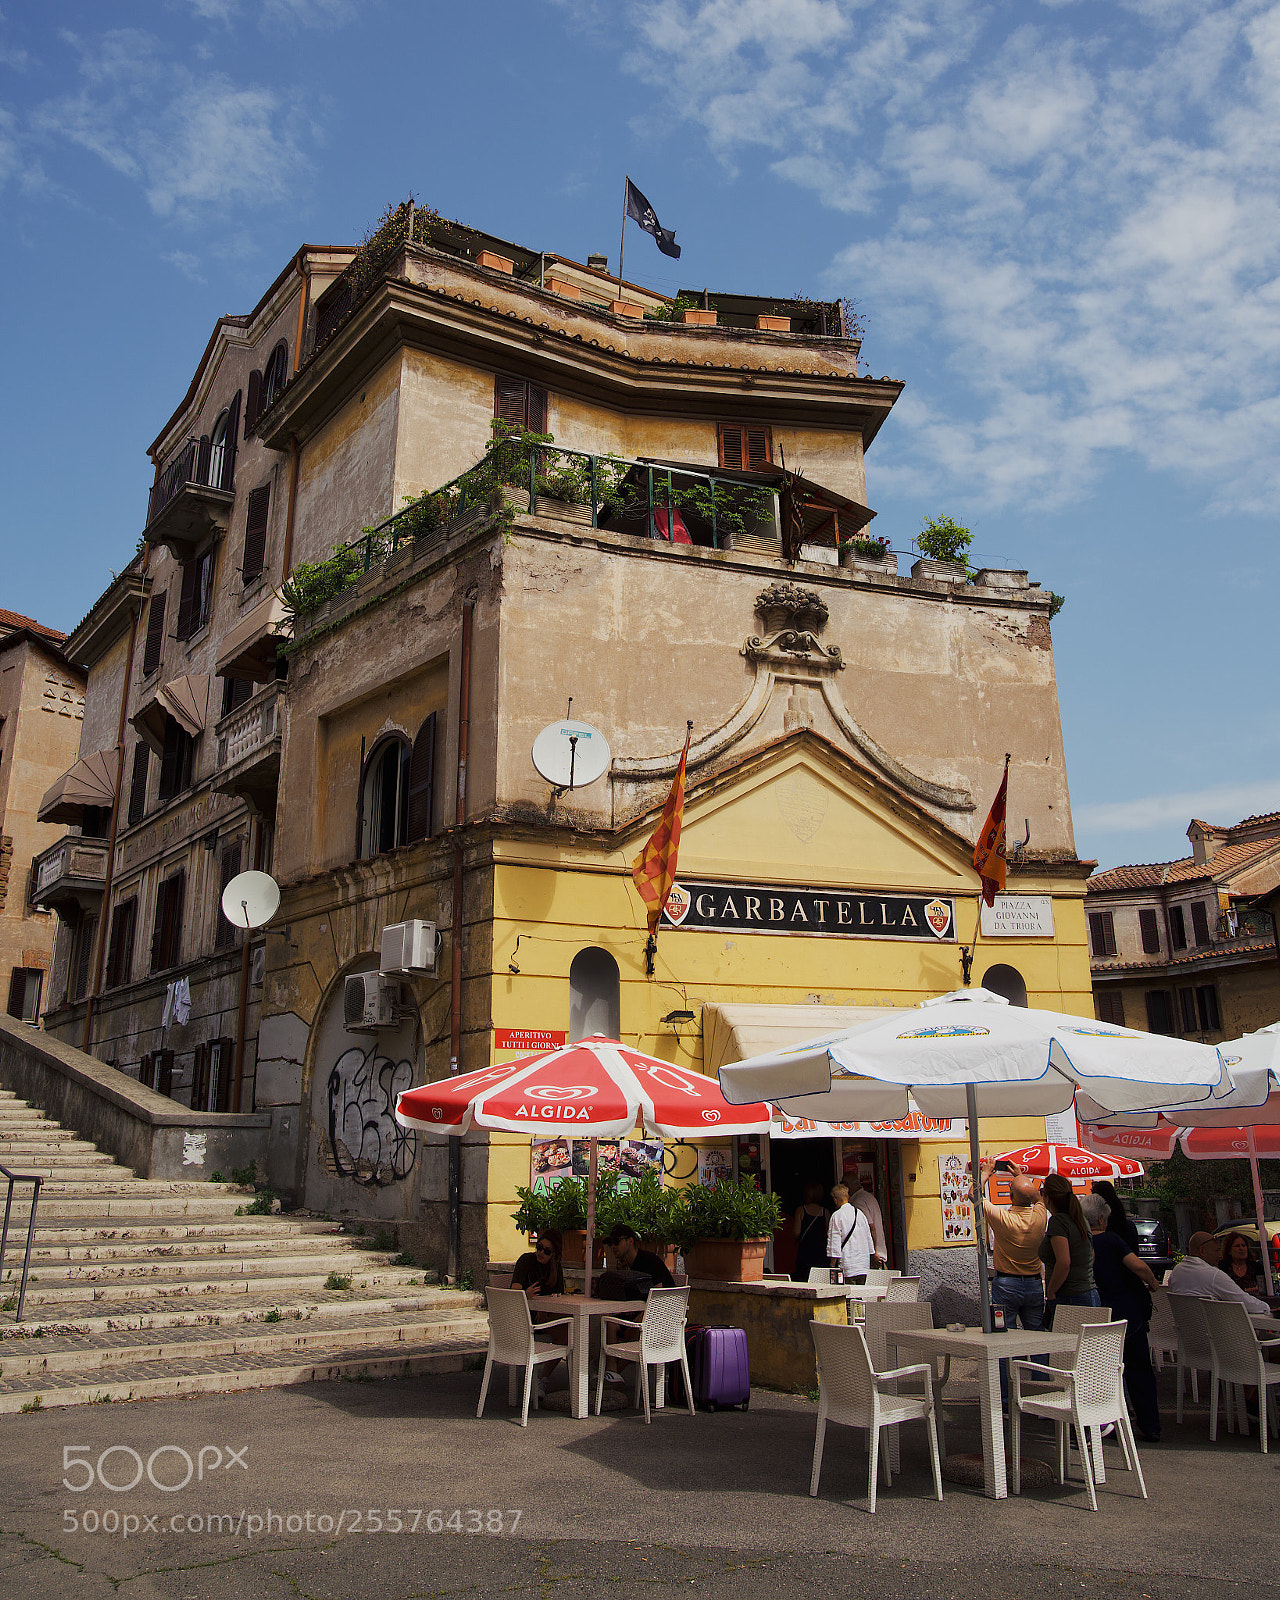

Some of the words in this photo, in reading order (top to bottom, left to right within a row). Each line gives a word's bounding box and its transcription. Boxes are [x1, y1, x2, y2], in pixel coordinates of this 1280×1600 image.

[696, 893, 919, 927] GARBATELLA
[1001, 901, 1032, 910] PIAZZA
[995, 911, 1039, 920] GIOVANNI
[994, 922, 1007, 930] DA
[1010, 922, 1042, 930] TRIORA
[509, 1031, 552, 1039] APERITIVO
[531, 1041, 560, 1050] GIORNI
[515, 1104, 590, 1120] ALGIDA
[1070, 1167, 1100, 1176] ALGIDA
